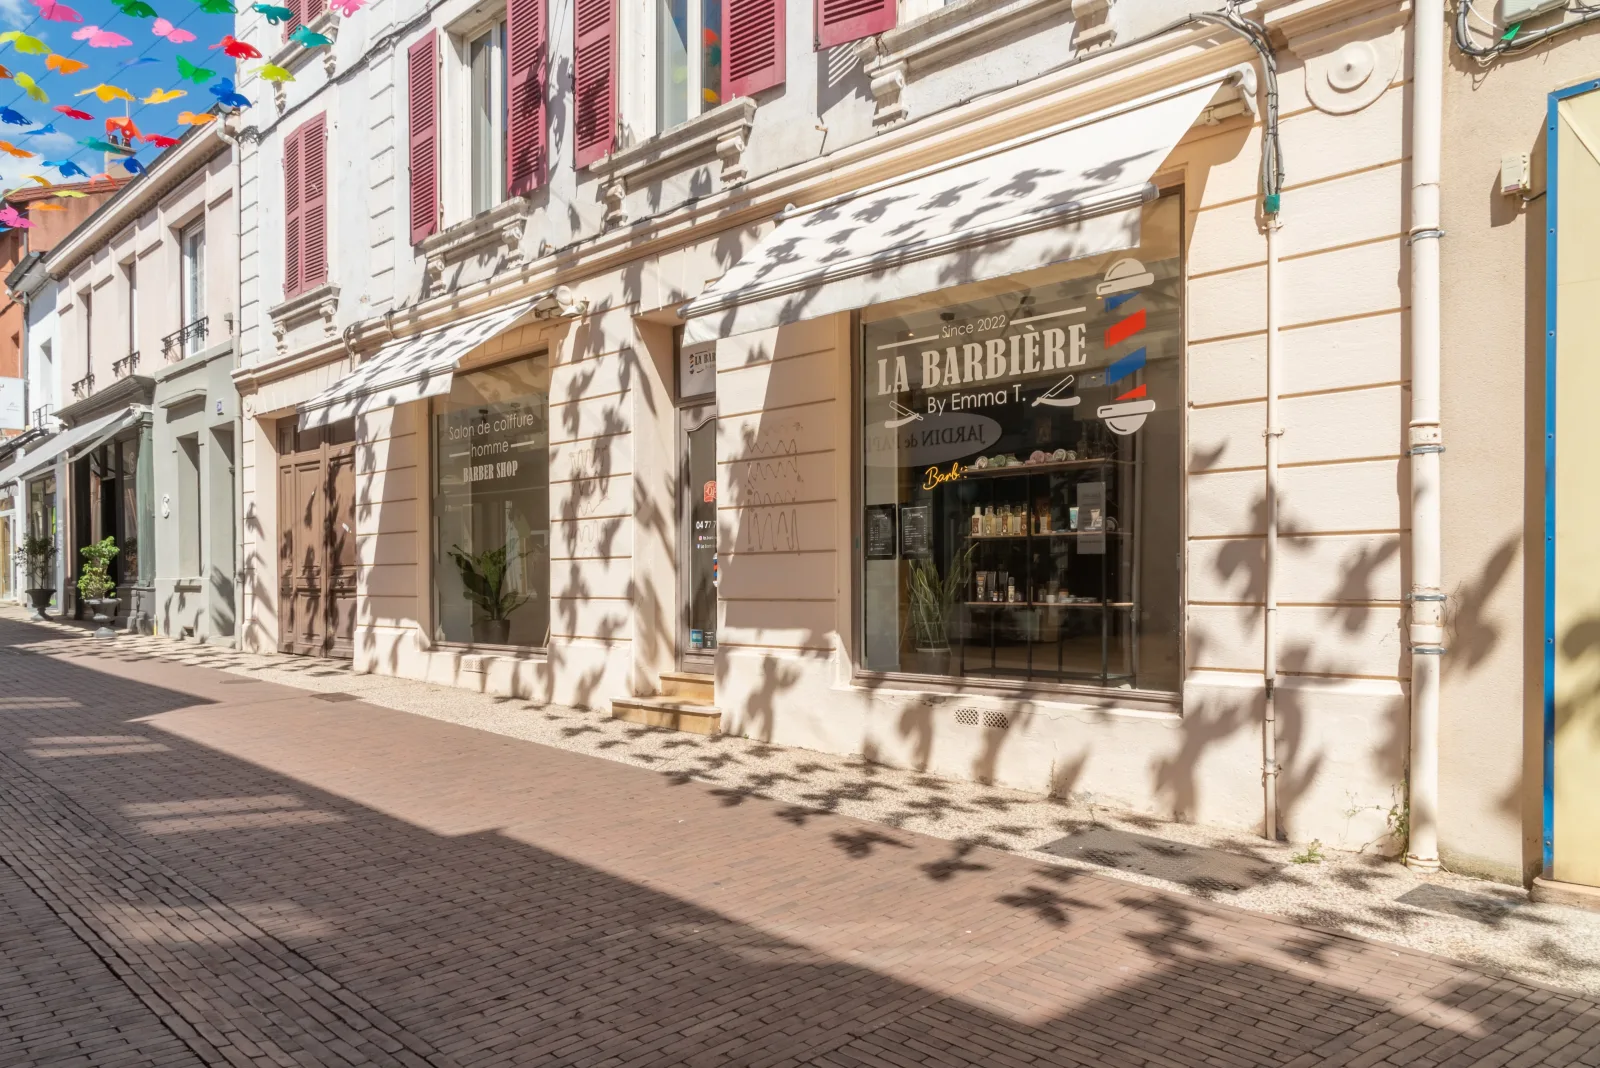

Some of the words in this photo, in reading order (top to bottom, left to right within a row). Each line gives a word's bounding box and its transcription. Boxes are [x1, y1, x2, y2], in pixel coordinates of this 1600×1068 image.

[941, 321, 974, 339] Since
[977, 314, 1006, 333] 2022
[877, 355, 910, 396] LA
[921, 323, 1087, 389] BARBIÈRE
[927, 396, 947, 416] By
[951, 389, 1007, 411] Emma
[1012, 384, 1026, 402] T.
[449, 425, 475, 440] Salon
[477, 421, 491, 435] de
[493, 413, 534, 431] coiffure
[471, 441, 509, 457] homme
[463, 464, 494, 482] BARBER
[496, 460, 518, 479] SHOP
[695, 520, 704, 530] 04
